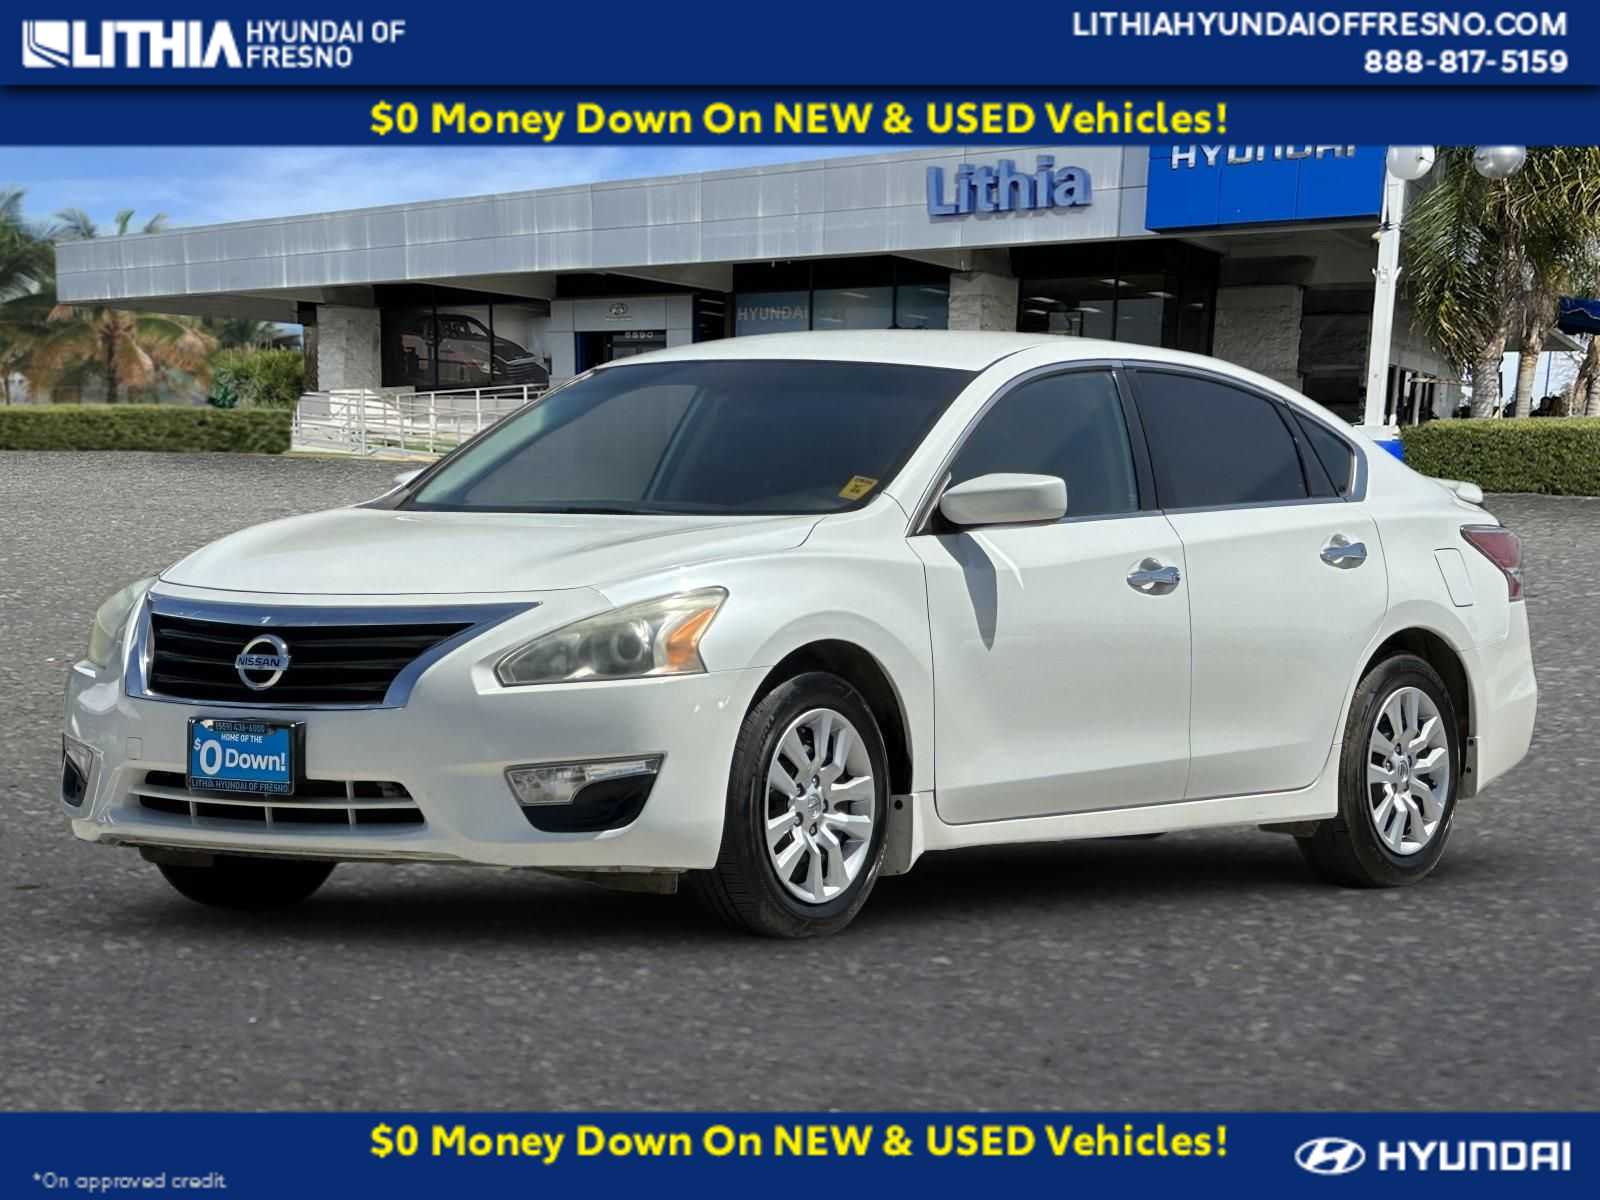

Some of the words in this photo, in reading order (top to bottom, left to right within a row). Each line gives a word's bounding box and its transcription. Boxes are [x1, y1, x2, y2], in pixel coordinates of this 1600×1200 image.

[927, 154, 1092, 216] Lithia
[737, 305, 809, 321] HYUNDAI
[239, 656, 280, 667] NISSAN
[221, 733, 239, 742] HOME
[240, 734, 250, 743] OF
[250, 735, 263, 744] THE
[225, 748, 286, 772] Down!
[216, 780, 247, 790] HYUNDAI
[248, 782, 258, 791] OF
[259, 782, 288, 793] FRESNO
